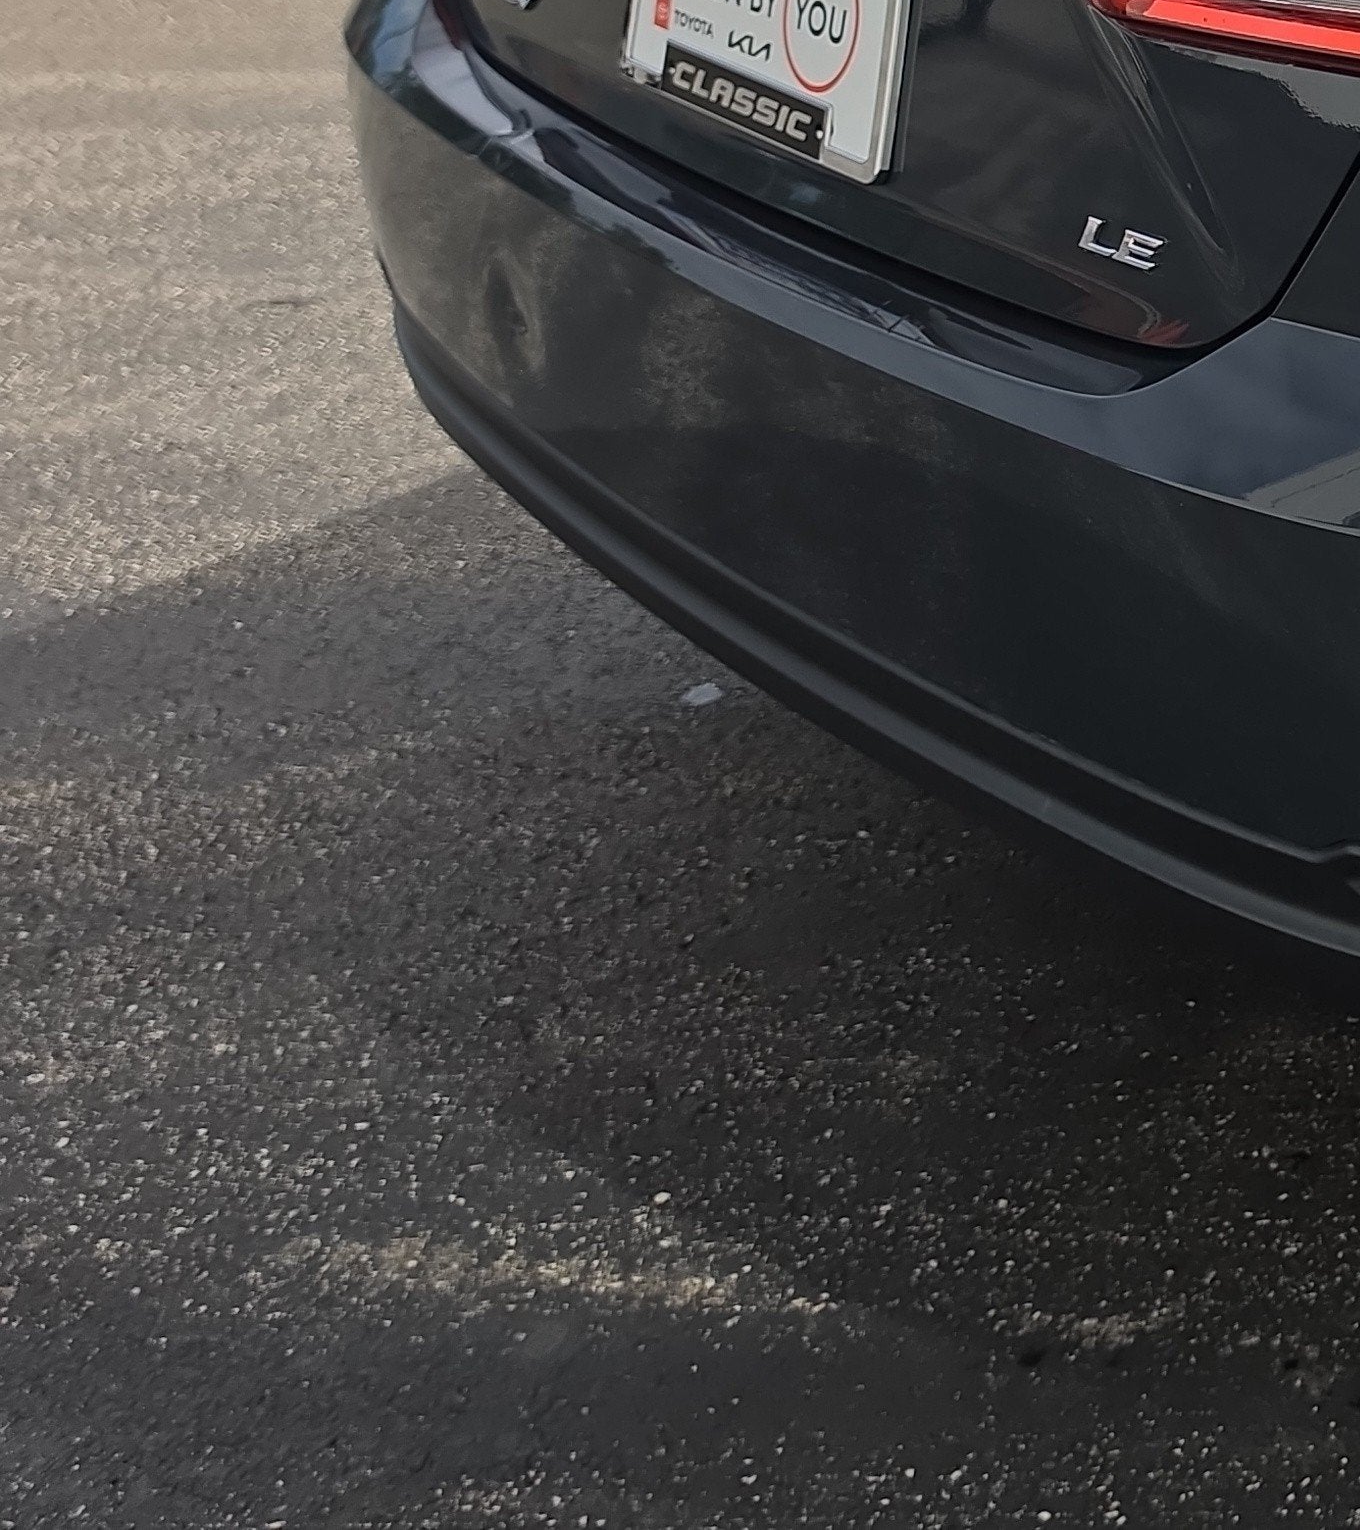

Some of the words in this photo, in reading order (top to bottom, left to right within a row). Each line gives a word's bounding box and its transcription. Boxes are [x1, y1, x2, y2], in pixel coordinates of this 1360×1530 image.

[673, 9, 714, 37] TOYOTA
[671, 58, 813, 141] CLASSIC
[1078, 215, 1166, 272] LE
